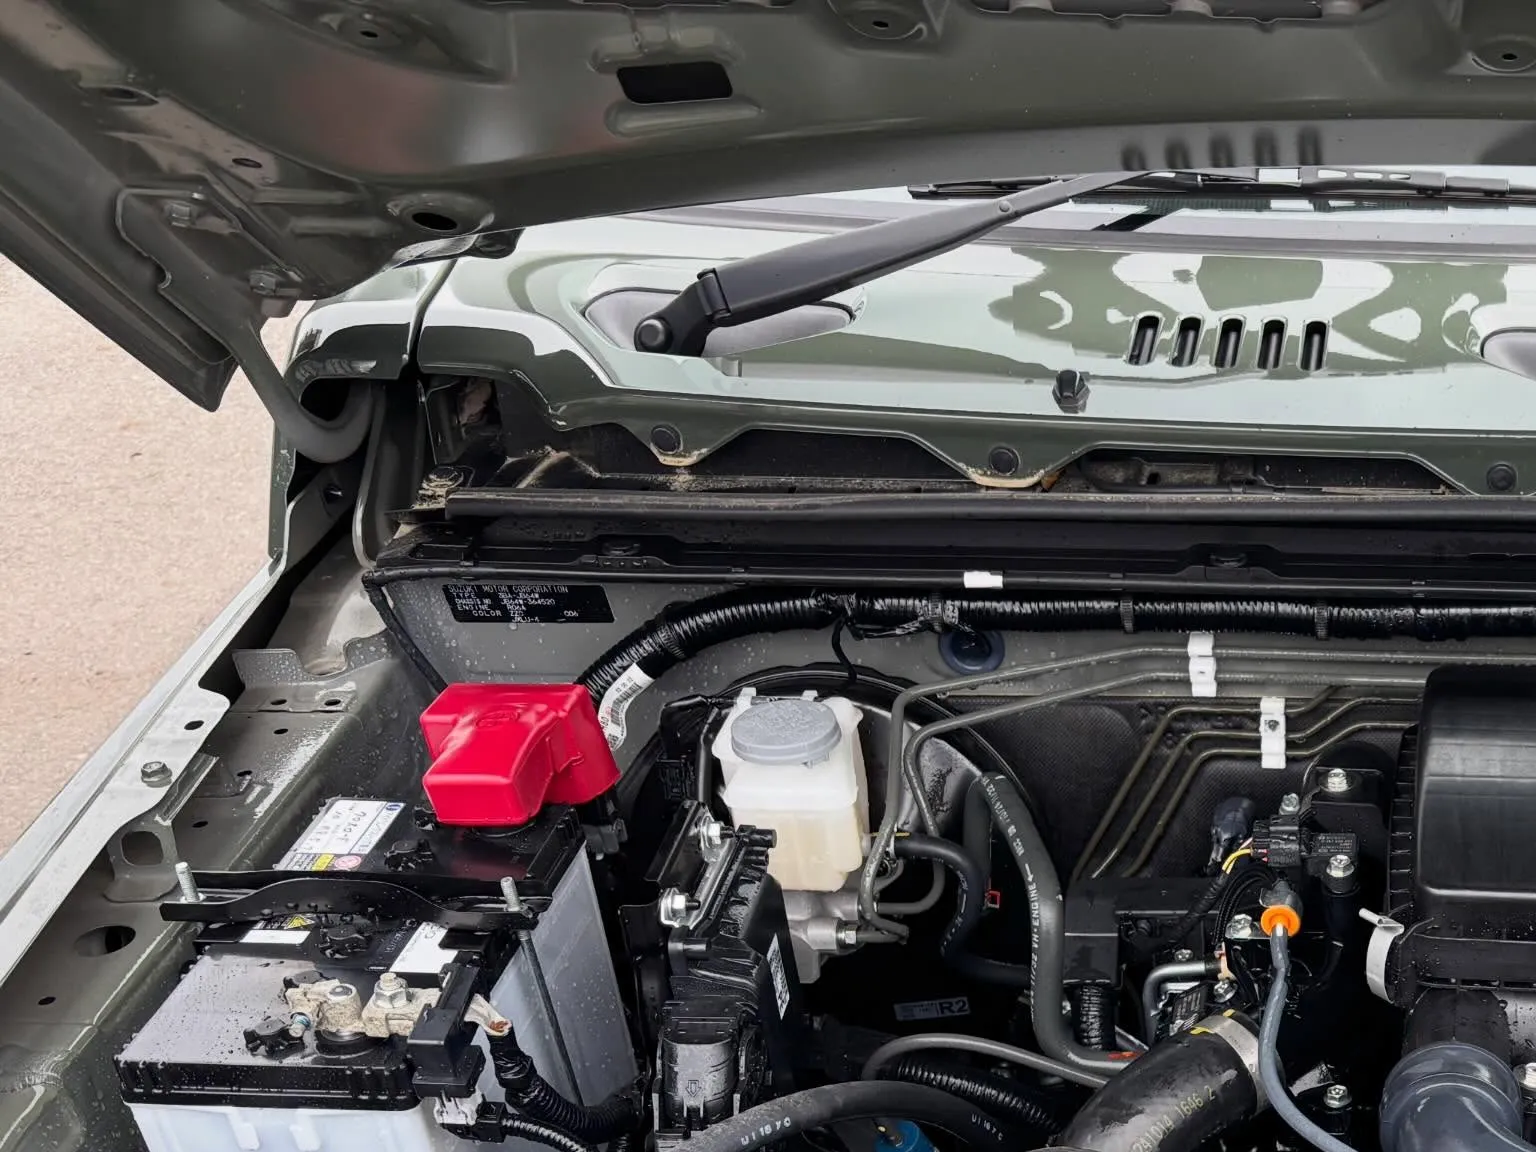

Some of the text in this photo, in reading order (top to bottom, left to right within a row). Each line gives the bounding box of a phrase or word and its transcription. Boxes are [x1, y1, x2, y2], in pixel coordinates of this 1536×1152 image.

[450, 585, 569, 593] SUZUKI MOTOR CORPORATION
[940, 1000, 968, 1014] R2
[1176, 1093, 1204, 1120] 1646
